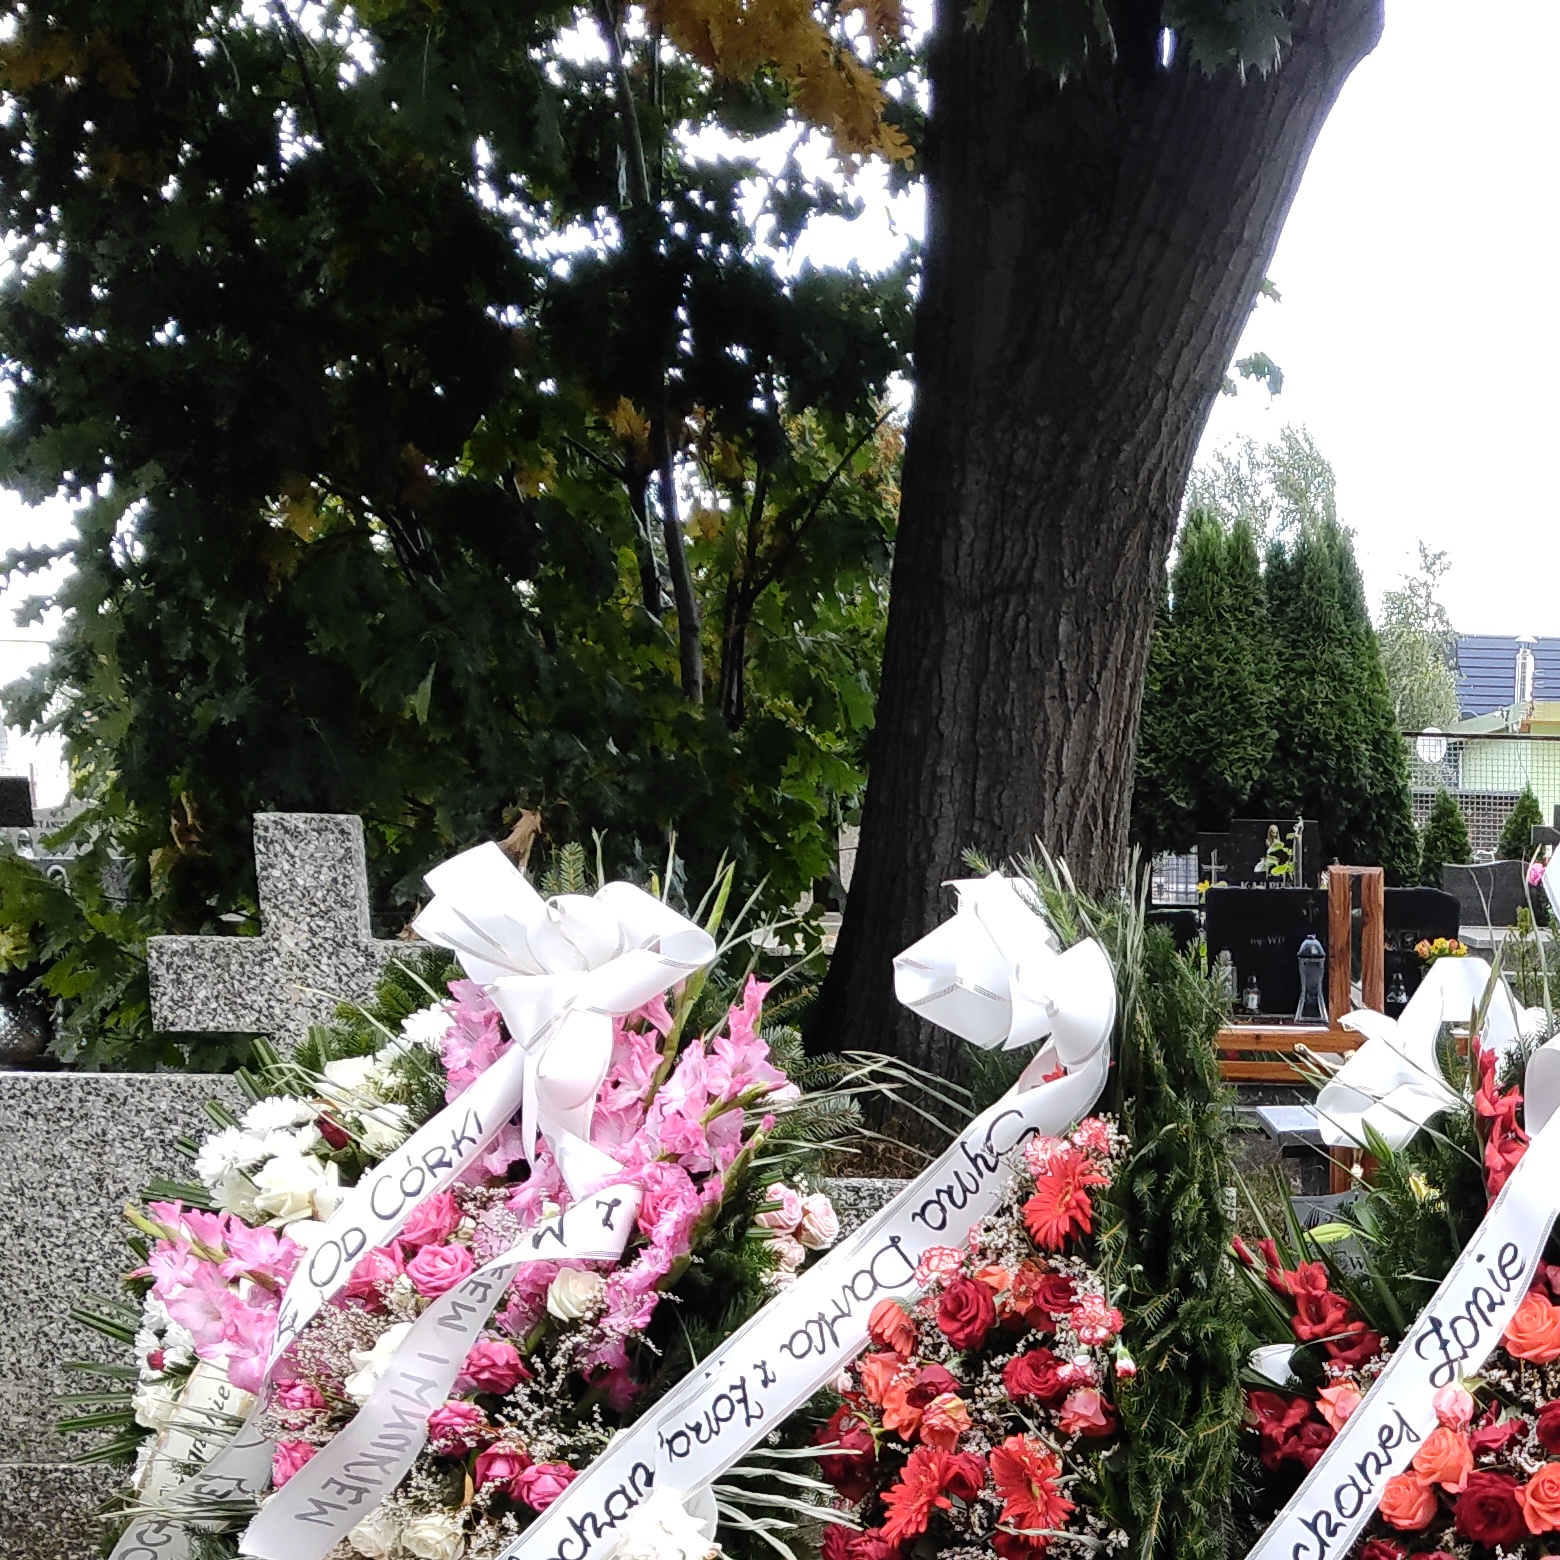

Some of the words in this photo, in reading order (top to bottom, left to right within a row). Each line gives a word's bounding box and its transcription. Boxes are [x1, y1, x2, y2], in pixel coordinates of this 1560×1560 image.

[308, 1225, 368, 1289] OD
[370, 1108, 483, 1221] CÓRKI
[778, 1233, 921, 1361] Darka
